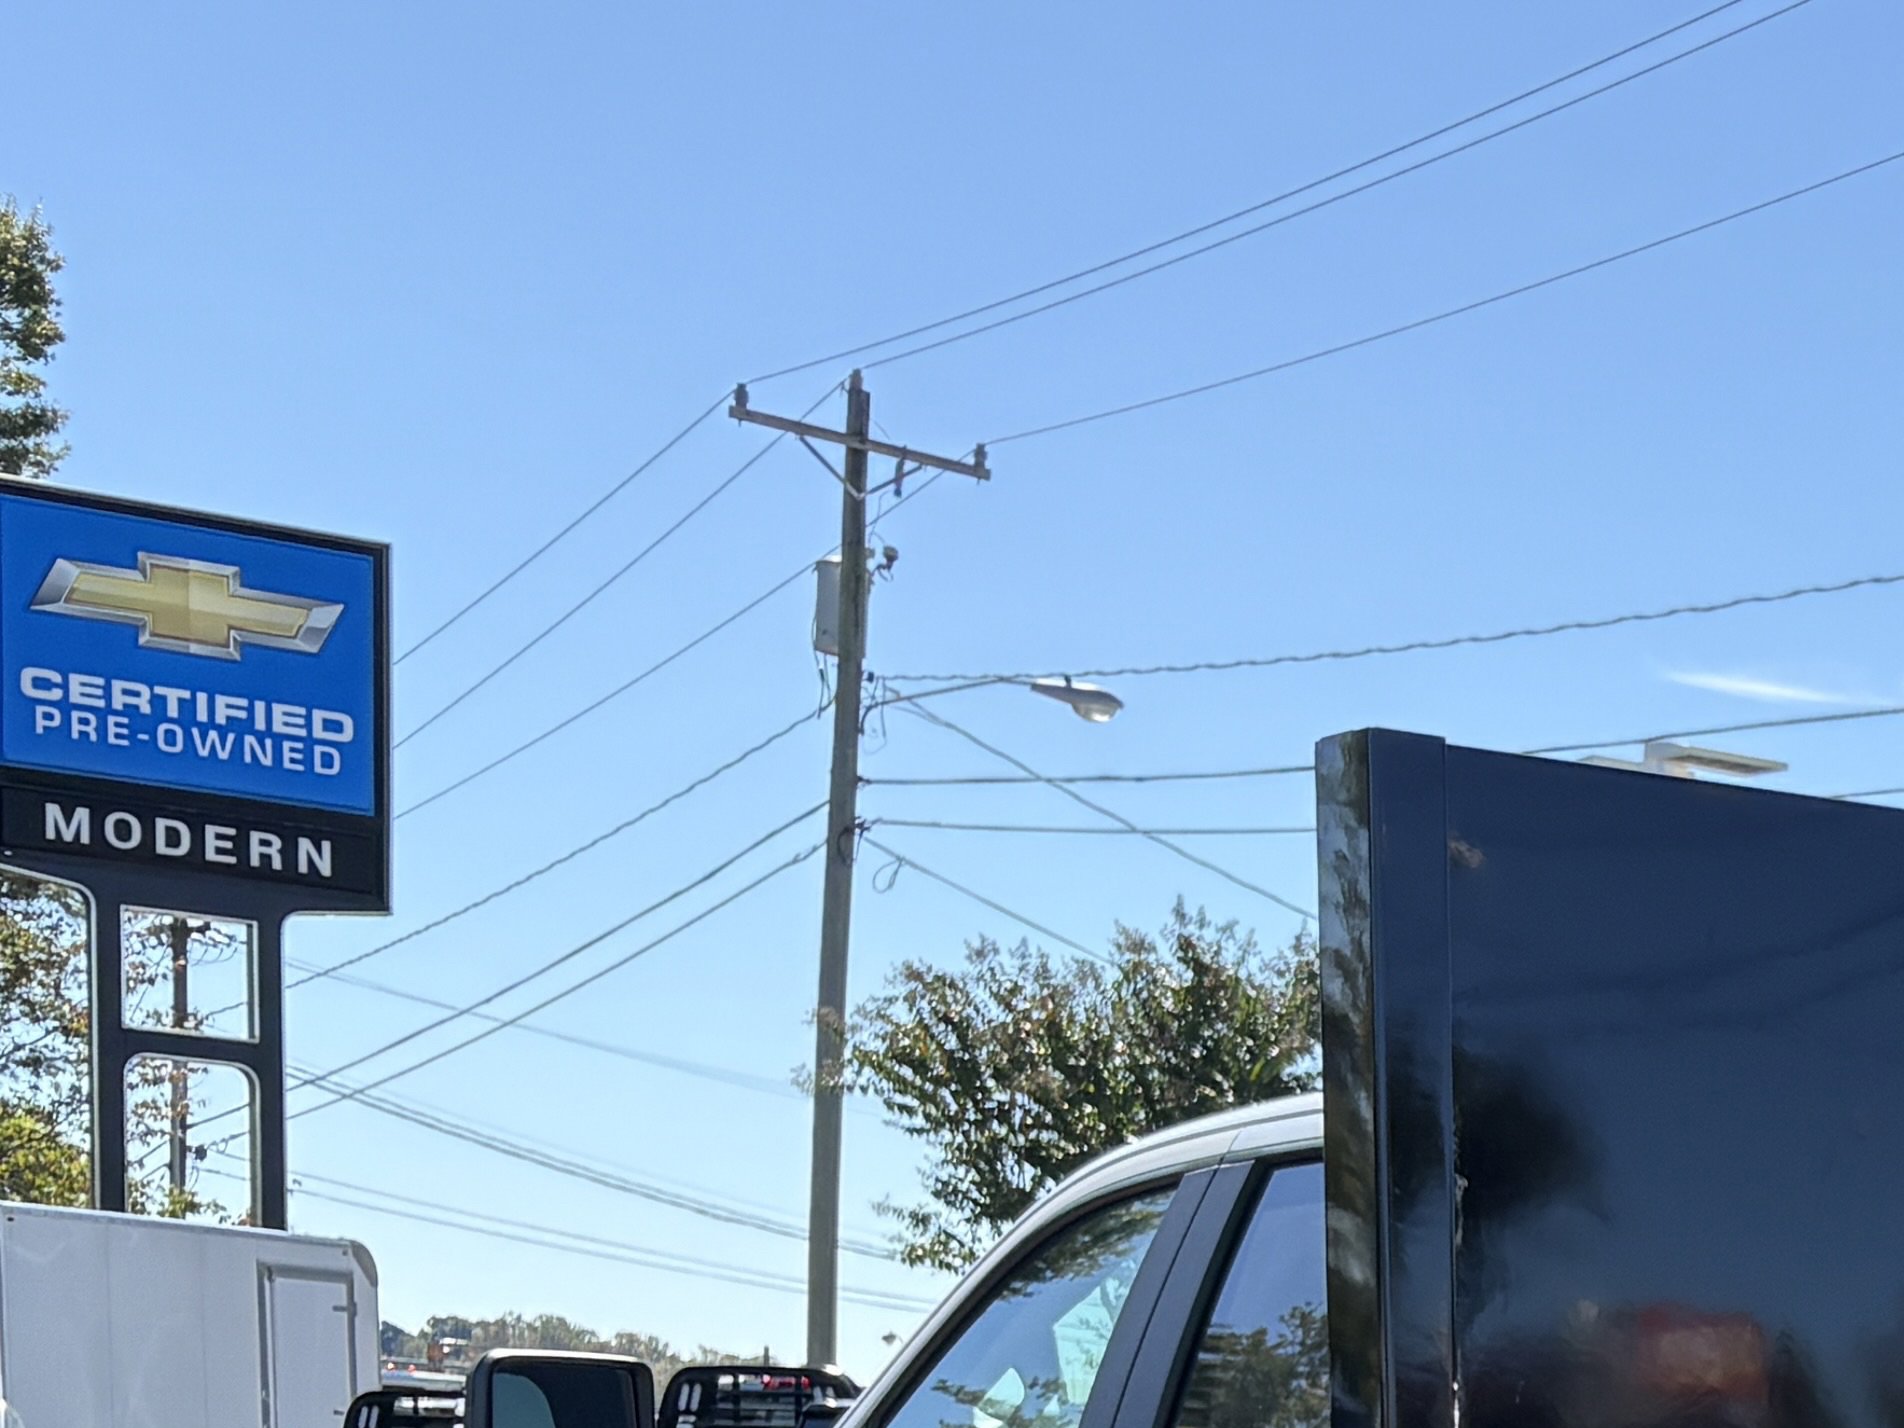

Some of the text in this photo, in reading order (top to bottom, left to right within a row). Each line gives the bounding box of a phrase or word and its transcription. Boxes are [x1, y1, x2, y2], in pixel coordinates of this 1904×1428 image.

[19, 665, 355, 745] CERTIFIED
[33, 704, 343, 777] PRE-OWNED
[43, 801, 334, 878] MODERN
